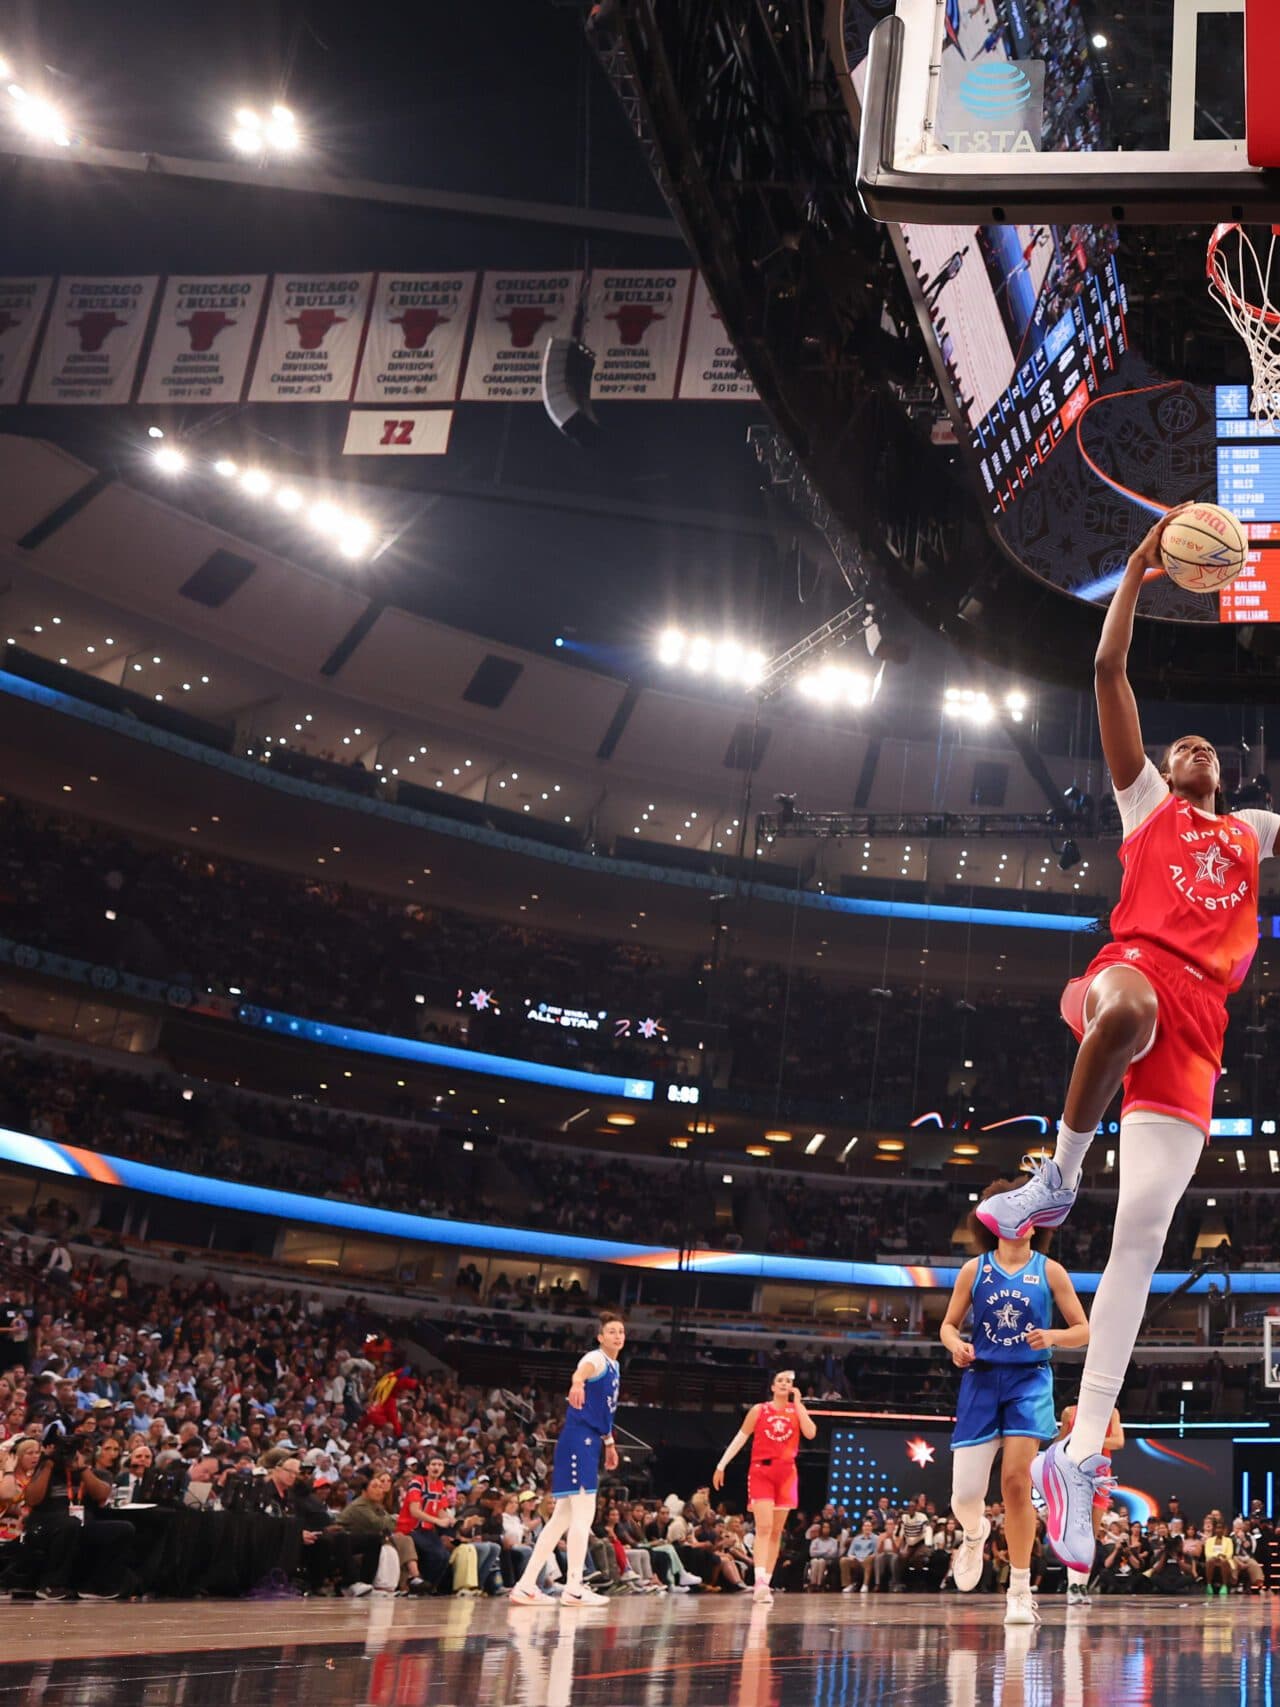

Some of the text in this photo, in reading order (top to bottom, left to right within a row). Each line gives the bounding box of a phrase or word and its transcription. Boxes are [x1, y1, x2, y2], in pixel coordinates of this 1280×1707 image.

[286, 281, 359, 293] CHICAGO
[390, 281, 462, 293] CHICAGO
[496, 278, 570, 290] CHICAGO
[604, 277, 676, 288] CHICAGO
[178, 283, 251, 296] CHICAGO
[185, 296, 241, 308] BULLS
[295, 295, 347, 306] BULLS
[399, 294, 450, 306] BULLS
[506, 292, 558, 304] BULLS
[613, 291, 665, 303] BULLS
[497, 351, 540, 360] CENTRAL
[607, 348, 648, 357] CENTRAL
[282, 362, 327, 371] DIVISION
[388, 362, 434, 371] DIVISION
[493, 363, 540, 372] DIVISION
[604, 360, 650, 369] DIVISION
[270, 374, 332, 383] CHAMPIONS
[376, 374, 438, 383] CHAMPIONS
[594, 372, 656, 381] CHAMPIONS
[1038, 380, 1056, 416] 6:27
[381, 420, 415, 445] 72
[1234, 580, 1267, 592] MALONGA
[1222, 596, 1232, 606] 22
[1234, 610, 1269, 620] WILLIAMS
[1169, 864, 1249, 911] ALL-STAR
[527, 1010, 598, 1030] ALL STAR
[986, 1289, 1030, 1307] WNBA
[982, 1320, 1035, 1346] ALL-STAR
